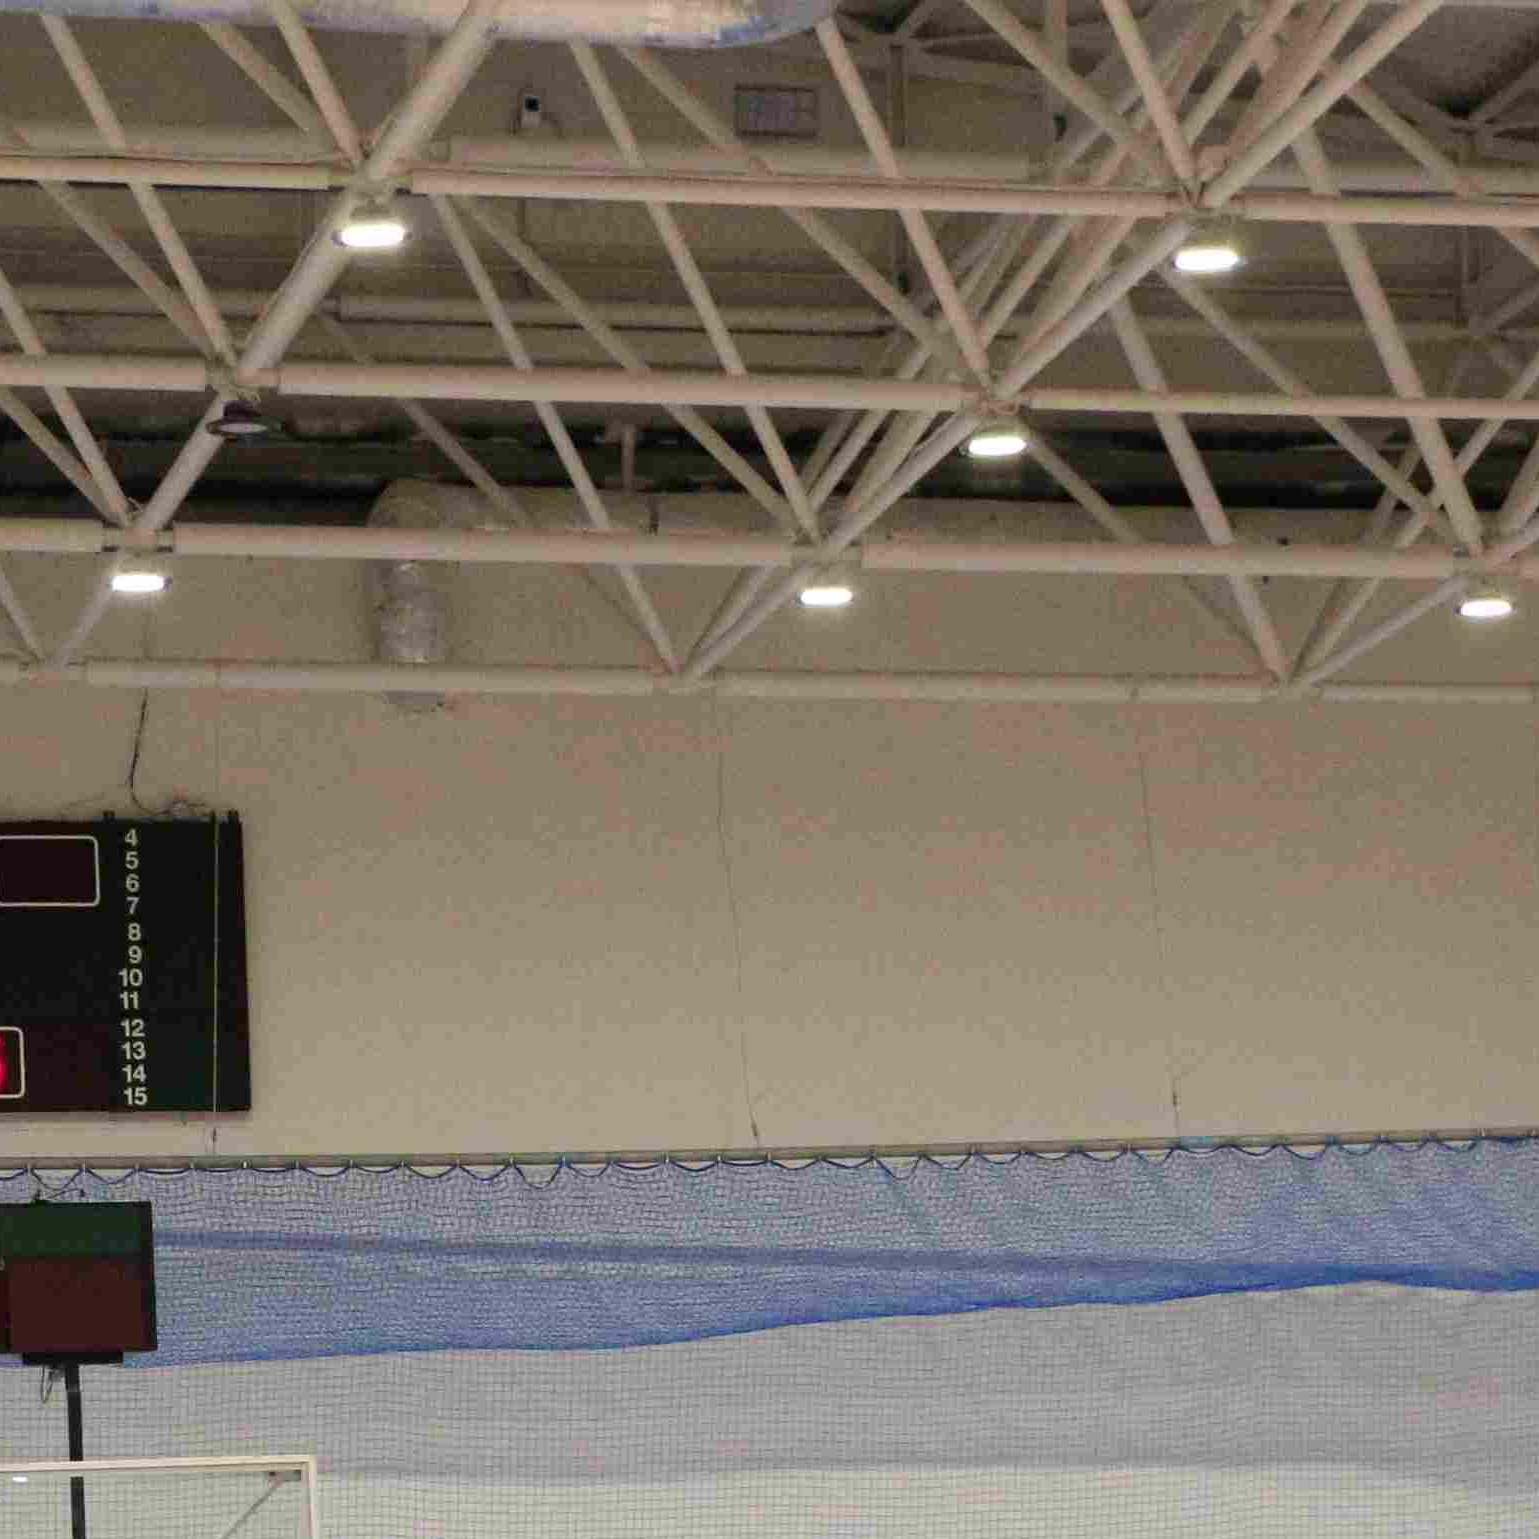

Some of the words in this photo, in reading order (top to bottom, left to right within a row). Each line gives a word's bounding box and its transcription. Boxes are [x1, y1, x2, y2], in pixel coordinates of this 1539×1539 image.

[124, 828, 138, 846] 4
[125, 850, 140, 869] 5
[125, 873, 140, 892] 6
[126, 896, 140, 915] 7
[127, 922, 142, 942] 8
[128, 945, 142, 964] 9
[119, 968, 143, 987] 10
[119, 991, 140, 1010] 11
[120, 1018, 145, 1038] 12
[121, 1040, 147, 1060] 13
[122, 1063, 147, 1083] 14
[123, 1086, 148, 1106] 15
